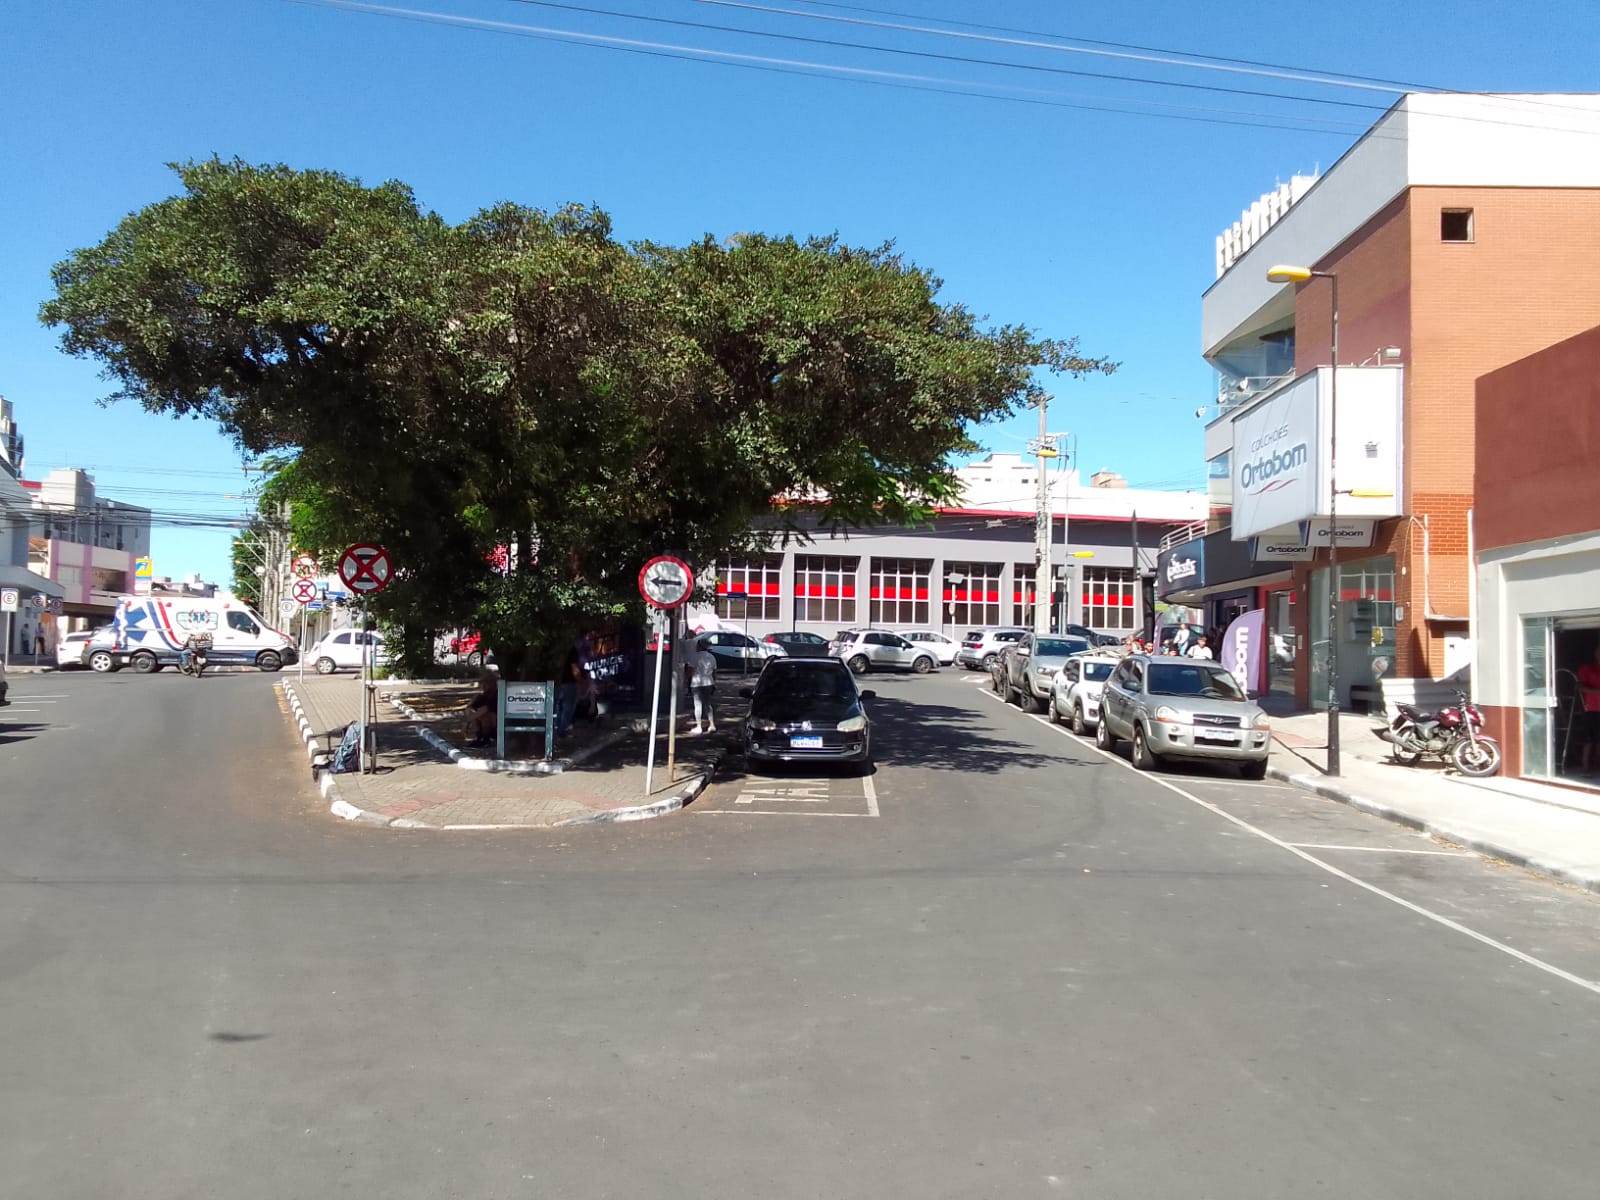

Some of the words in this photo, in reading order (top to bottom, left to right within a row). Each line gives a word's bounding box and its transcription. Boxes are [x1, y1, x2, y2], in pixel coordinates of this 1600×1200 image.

[1241, 443, 1307, 489] Ortobom
[1318, 529, 1363, 537] Orobom
[1266, 544, 1307, 553] Ortobom
